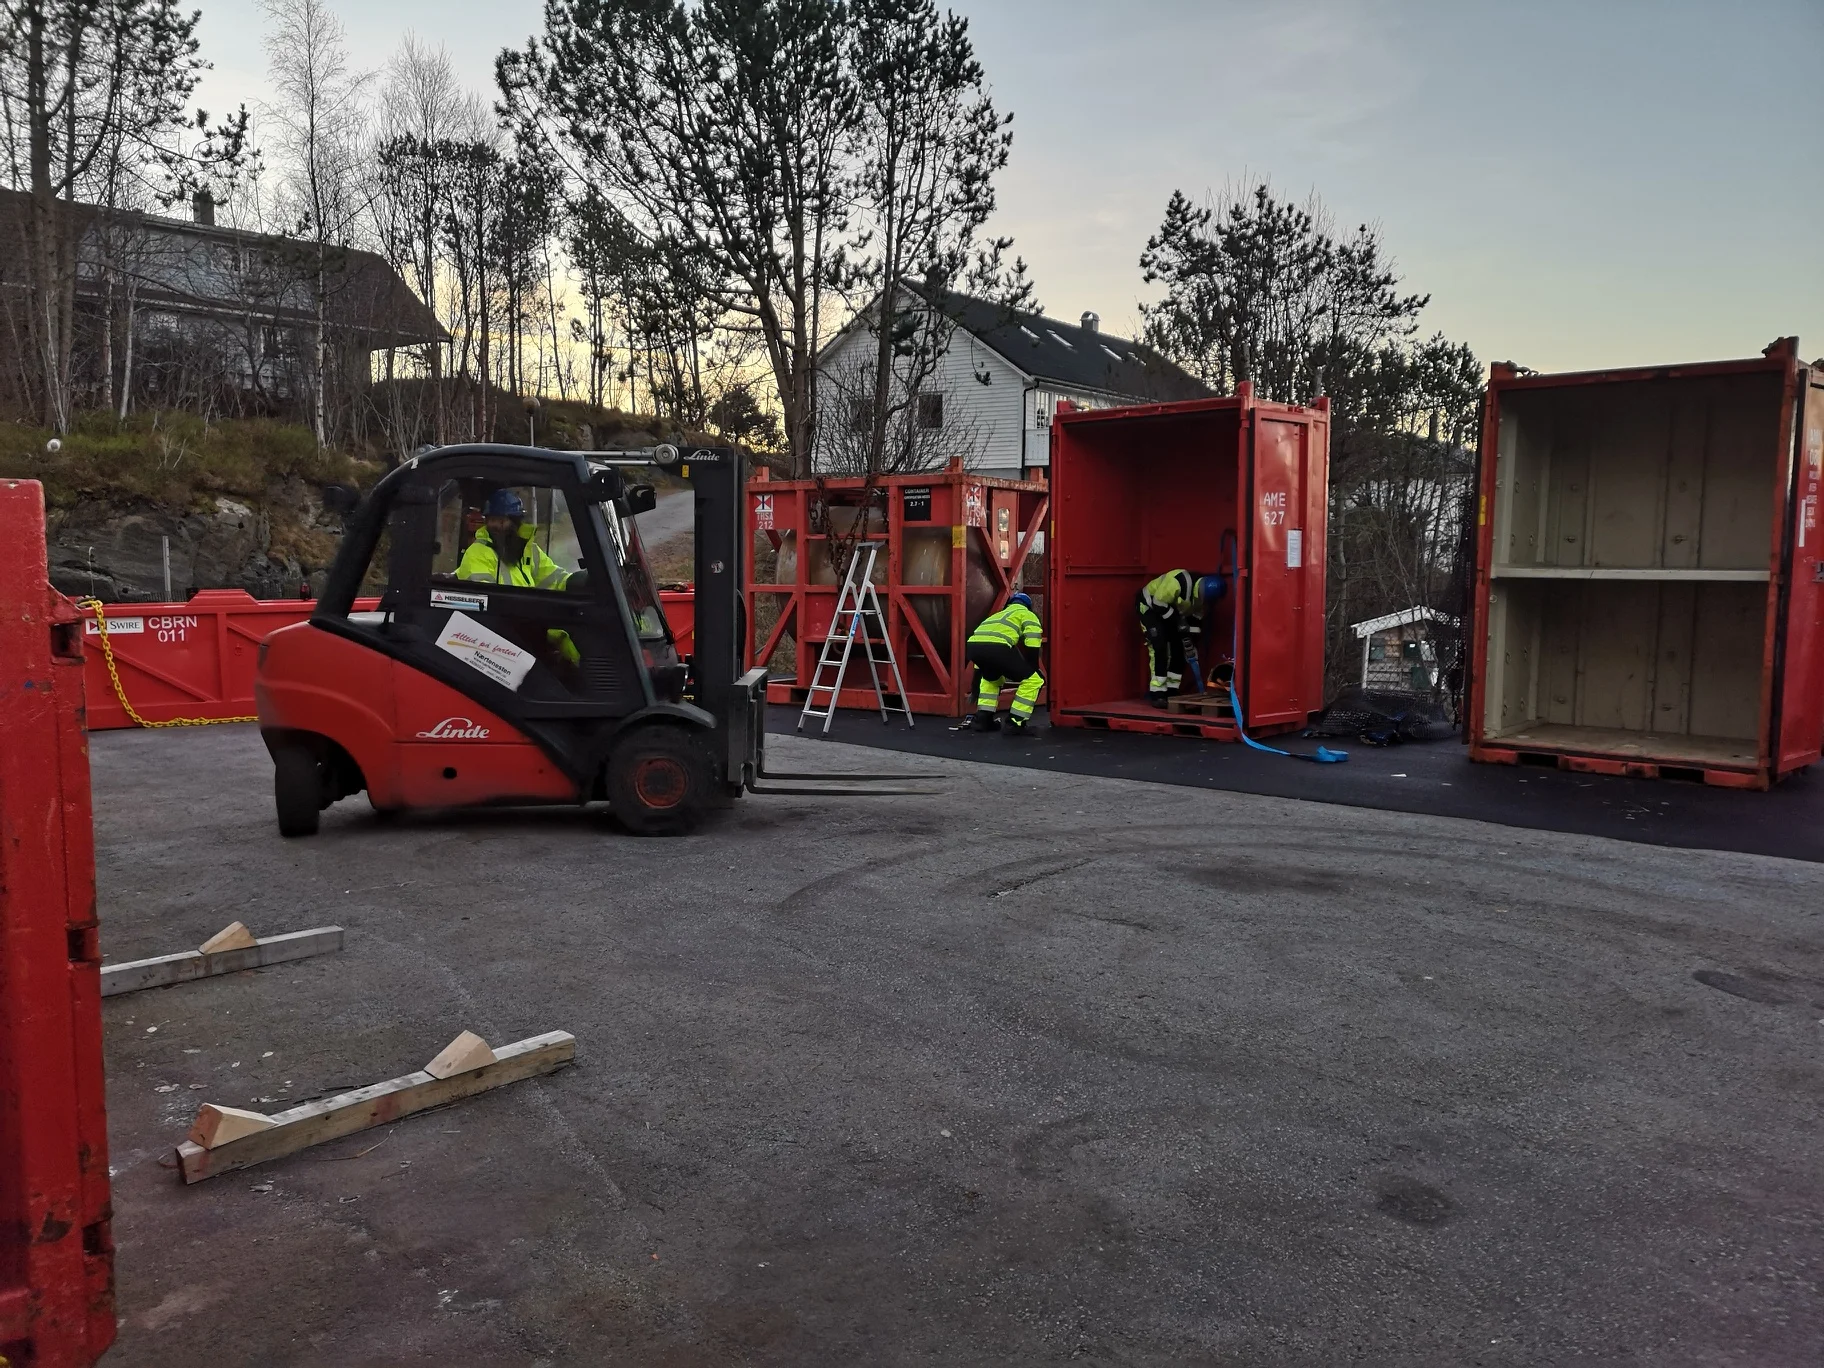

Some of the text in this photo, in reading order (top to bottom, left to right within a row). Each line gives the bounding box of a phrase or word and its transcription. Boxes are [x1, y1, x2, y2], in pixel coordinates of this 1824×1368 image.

[683, 449, 720, 461] Linde
[1263, 492, 1286, 507] AME
[758, 520, 773, 530] 212
[1264, 511, 1285, 526] 527
[110, 620, 140, 630] SWIRE
[148, 615, 198, 629] CBRN
[157, 628, 186, 643] 011
[415, 717, 490, 739] Linde
